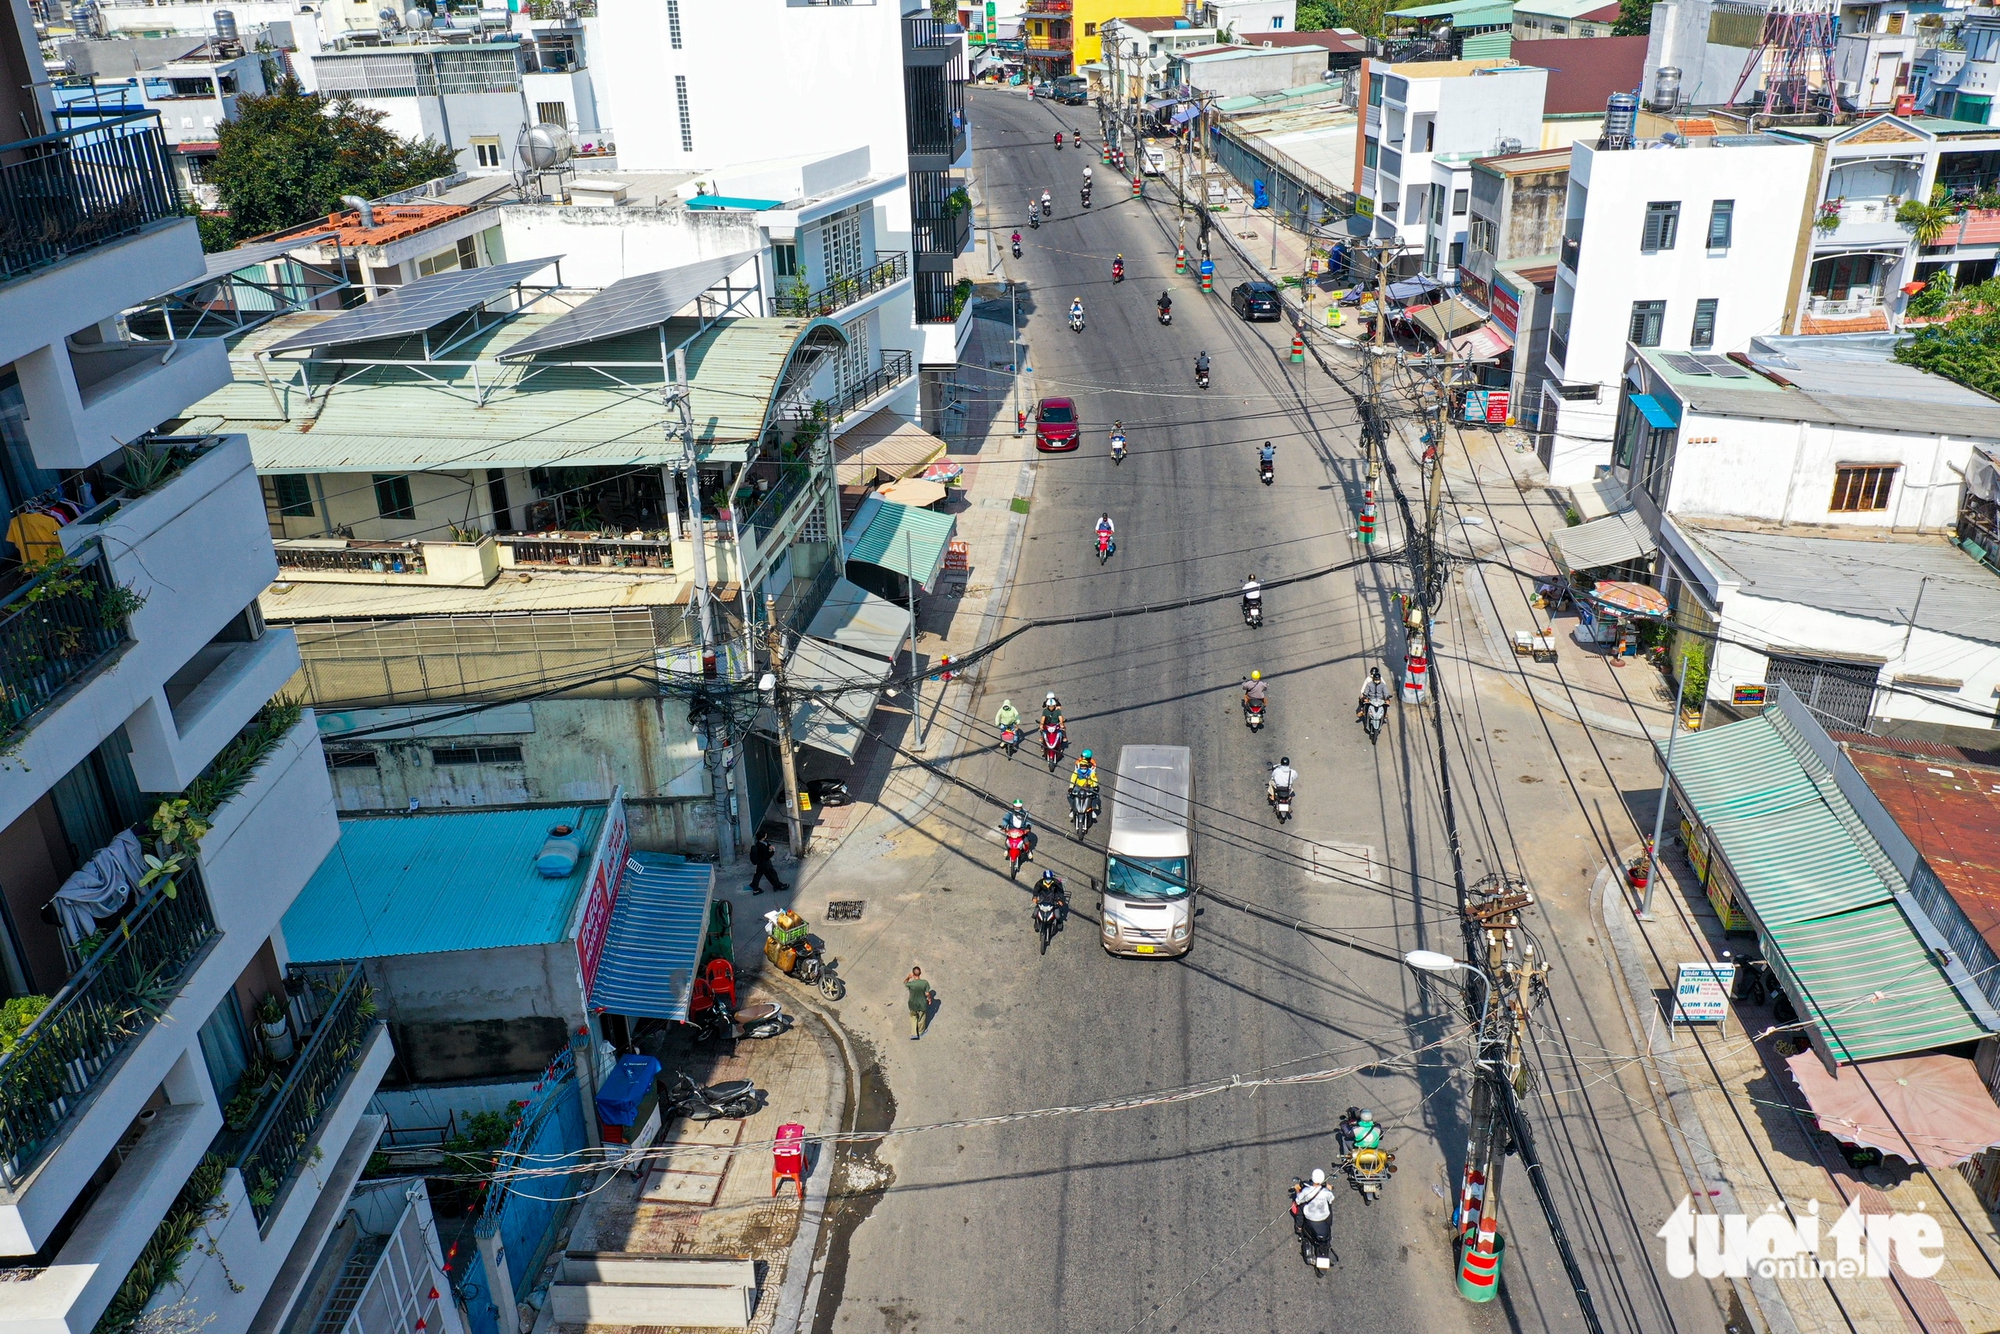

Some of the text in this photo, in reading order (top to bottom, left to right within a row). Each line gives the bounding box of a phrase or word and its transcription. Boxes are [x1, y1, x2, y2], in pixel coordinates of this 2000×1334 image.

[1467, 332, 1498, 356] MOTUL
[582, 880, 601, 952] ENEOS
[586, 920, 599, 967] MOTOR
[1680, 983, 1695, 994] BÚN
